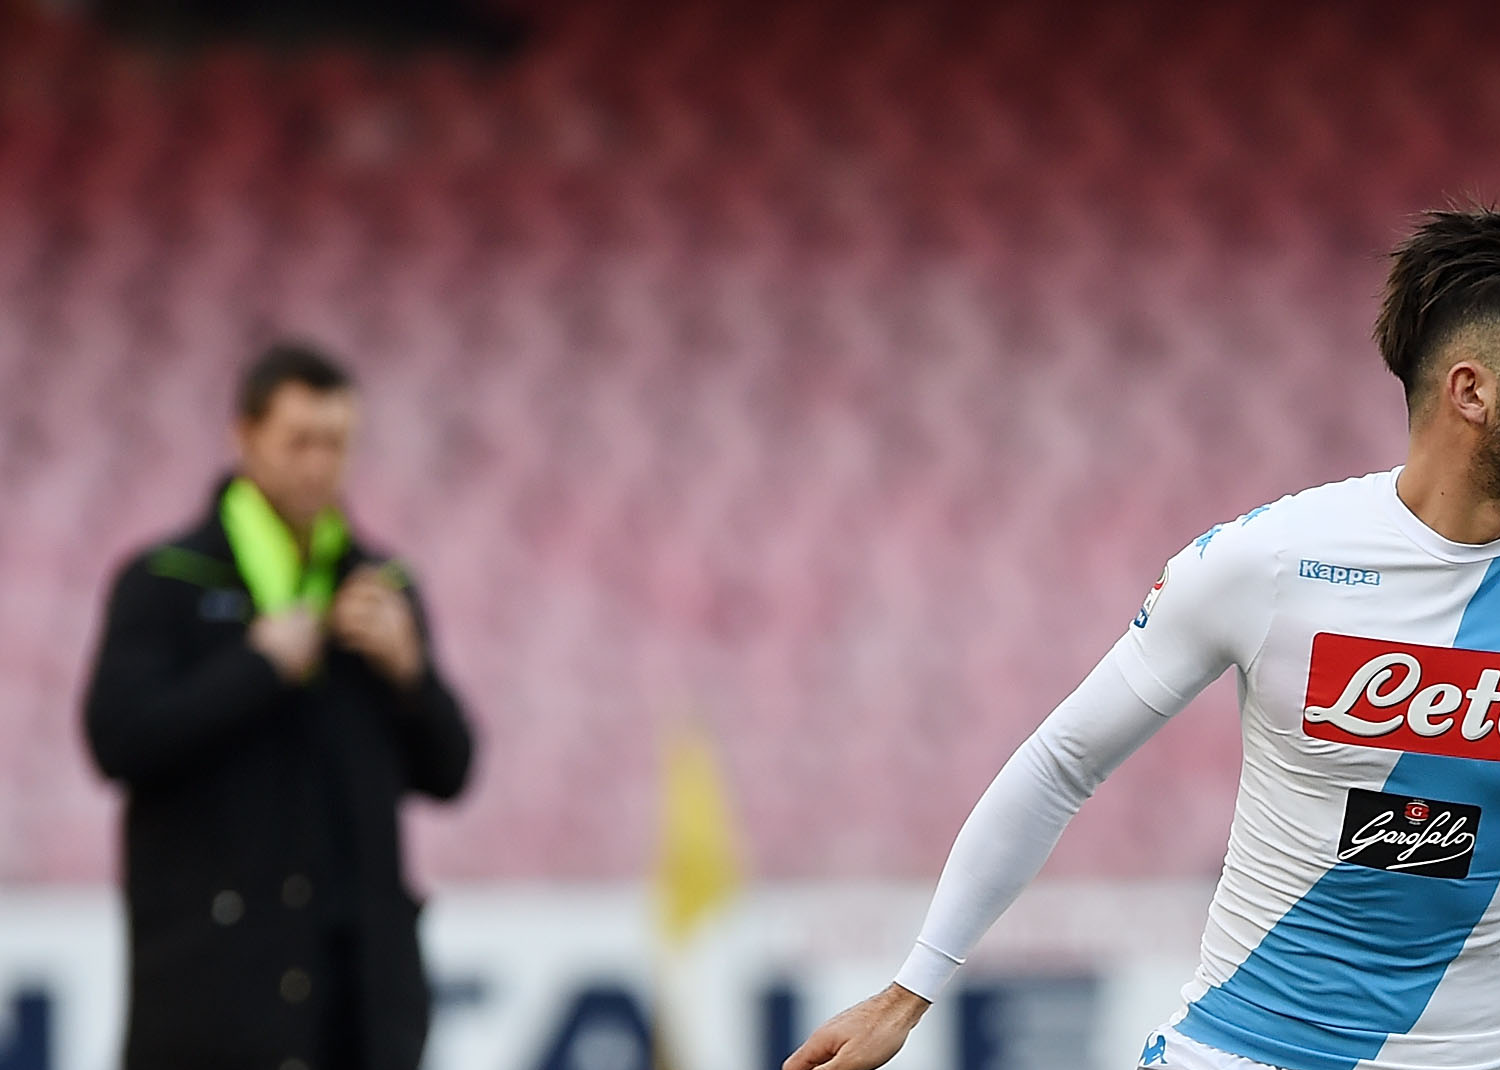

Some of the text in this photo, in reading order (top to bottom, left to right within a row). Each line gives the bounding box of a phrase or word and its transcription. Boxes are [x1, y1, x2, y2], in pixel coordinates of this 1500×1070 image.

[1300, 560, 1380, 585] Kappa
[1411, 806, 1423, 817] G
[1339, 811, 1475, 870] Garofalo
